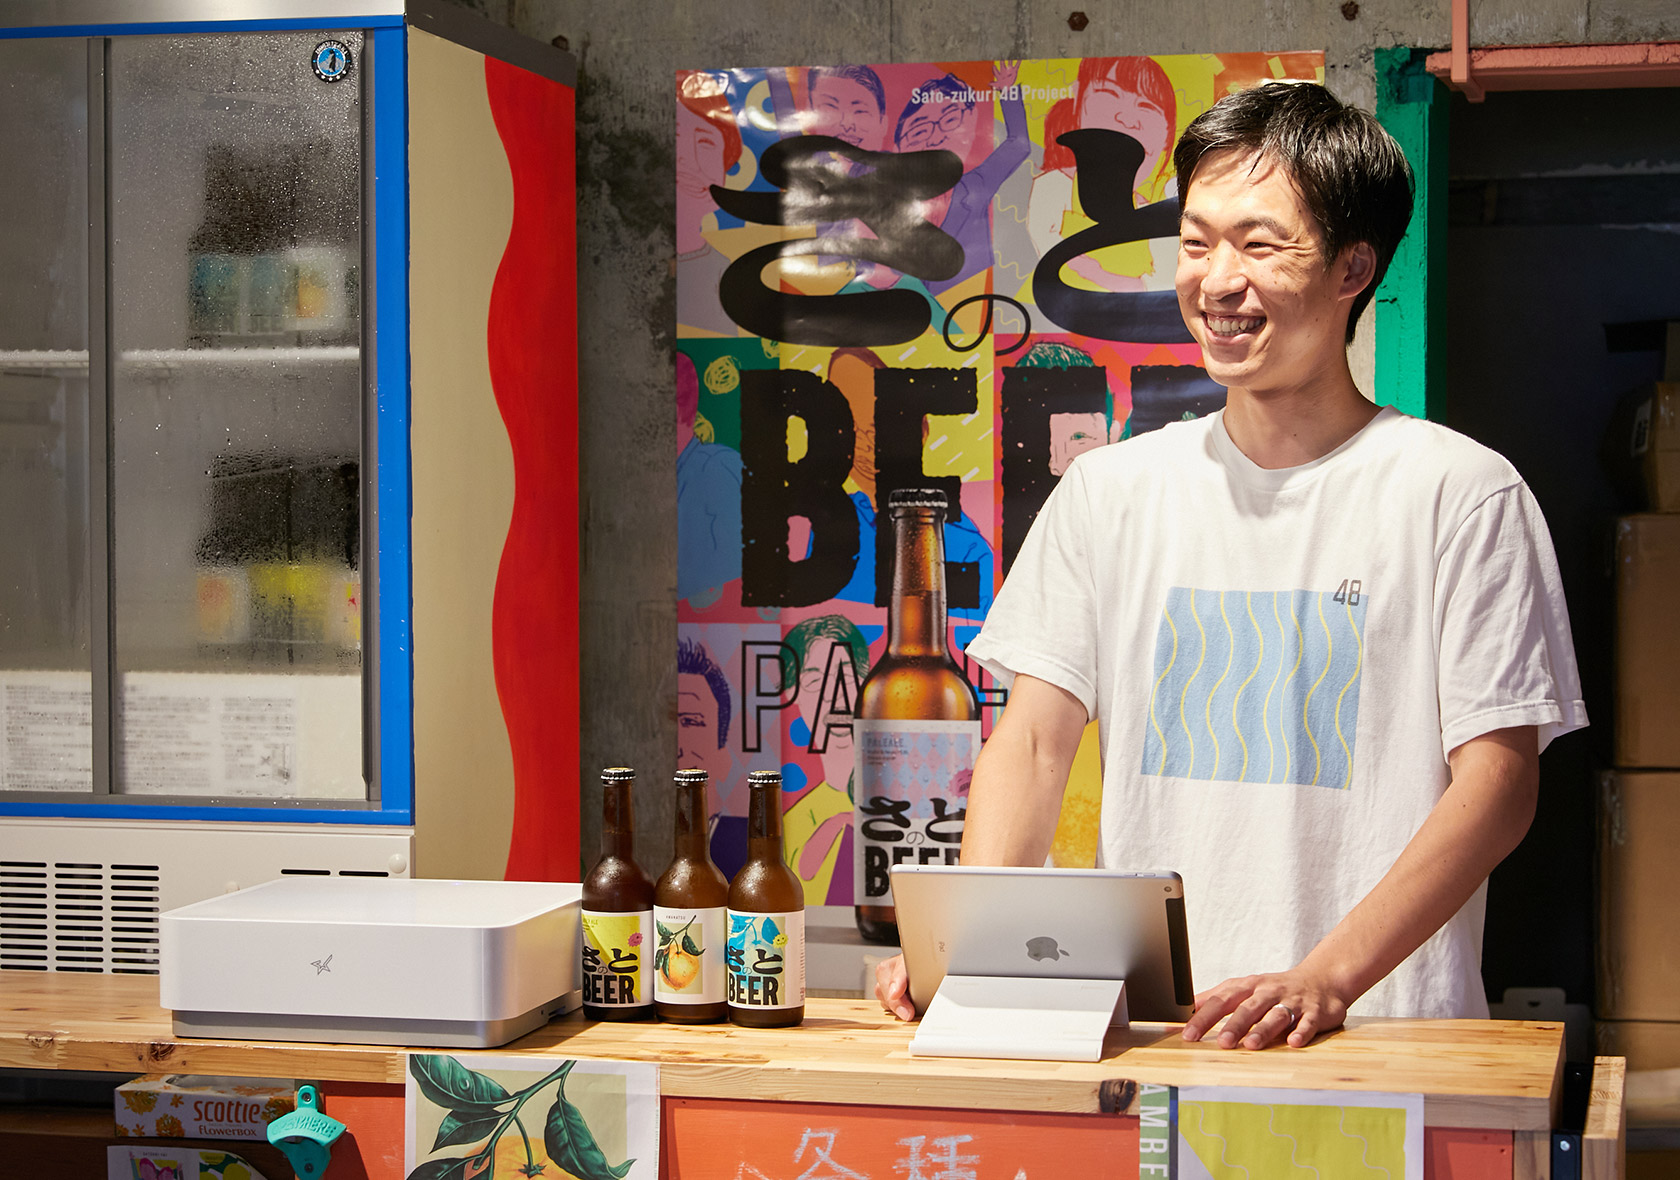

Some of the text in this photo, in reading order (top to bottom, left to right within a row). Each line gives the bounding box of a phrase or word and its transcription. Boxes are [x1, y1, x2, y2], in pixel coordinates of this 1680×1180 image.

[911, 87, 996, 104] Sato-zukuri
[1022, 83, 1074, 103] Project
[1333, 579, 1361, 606] 48
[583, 973, 635, 1004] BEER
[728, 973, 779, 1006] BEER
